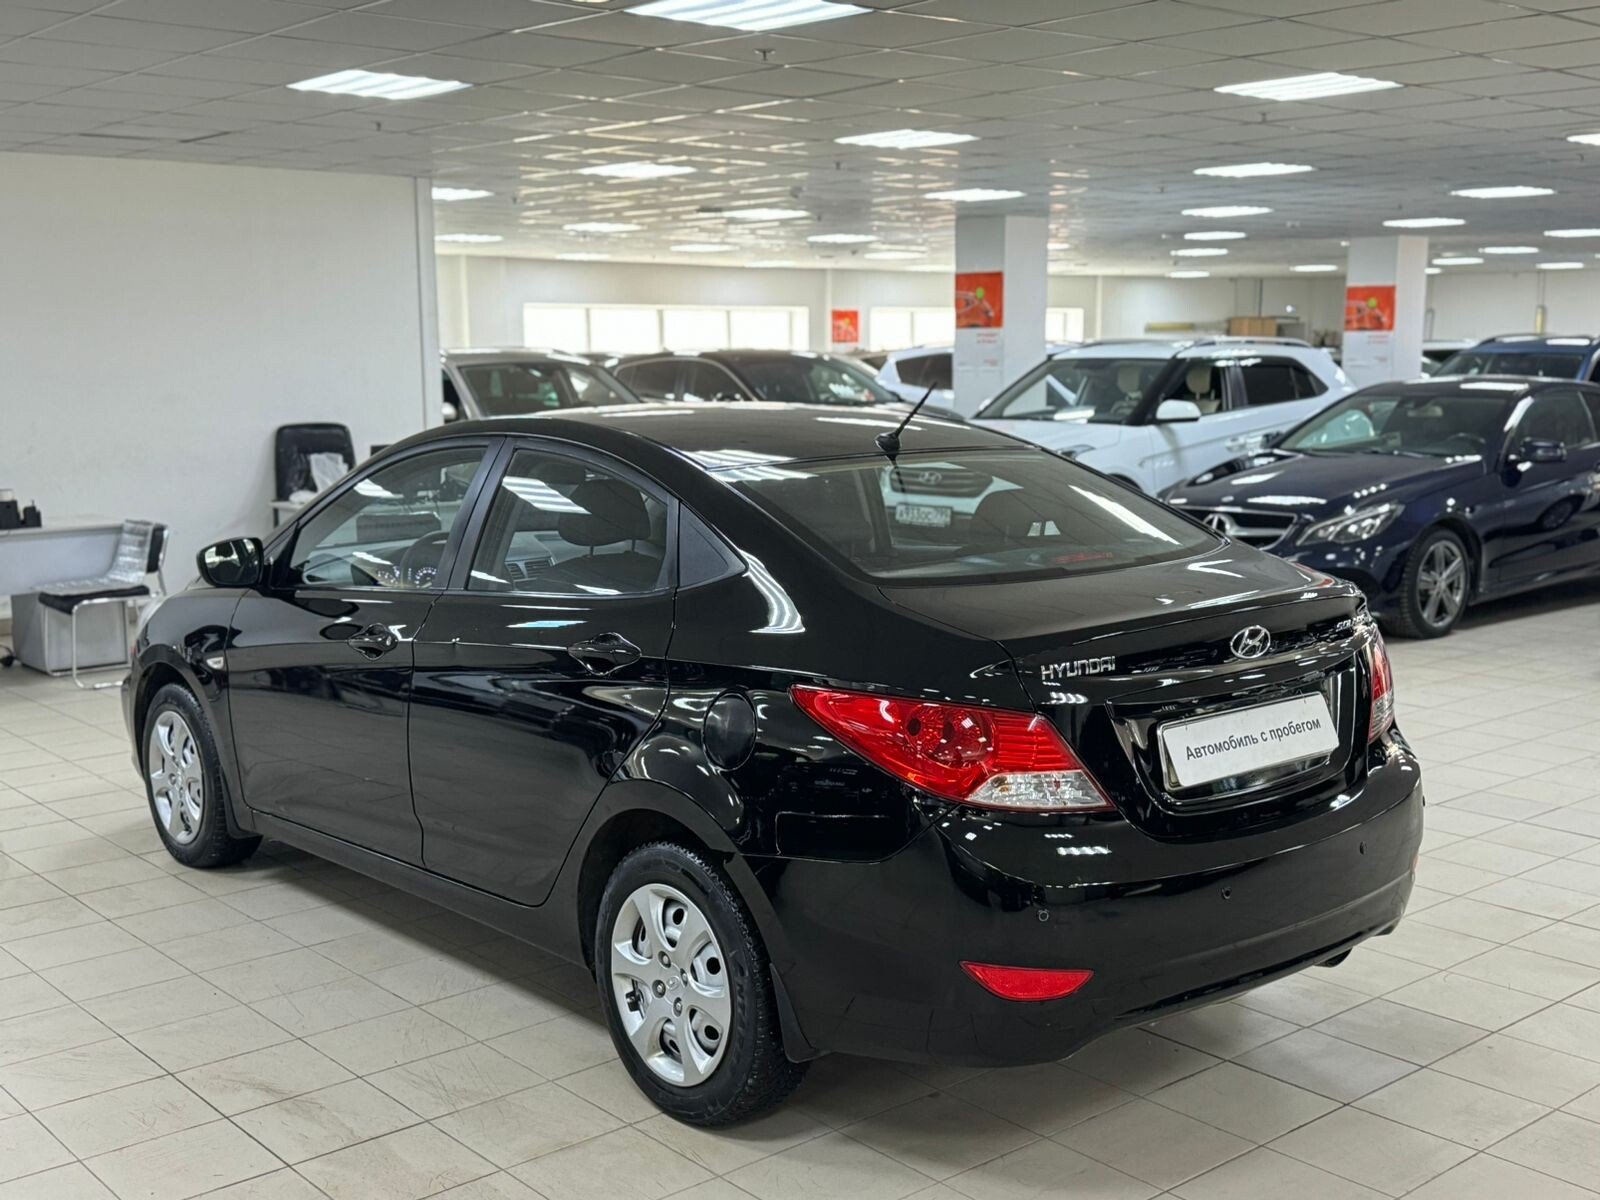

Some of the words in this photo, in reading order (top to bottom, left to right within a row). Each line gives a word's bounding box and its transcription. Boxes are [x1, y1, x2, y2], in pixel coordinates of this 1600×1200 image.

[1040, 656, 1116, 680] HYUNDAI
[1186, 735, 1259, 760] Автомобиль
[1260, 731, 1268, 742] с
[1269, 718, 1321, 742] пробегом
